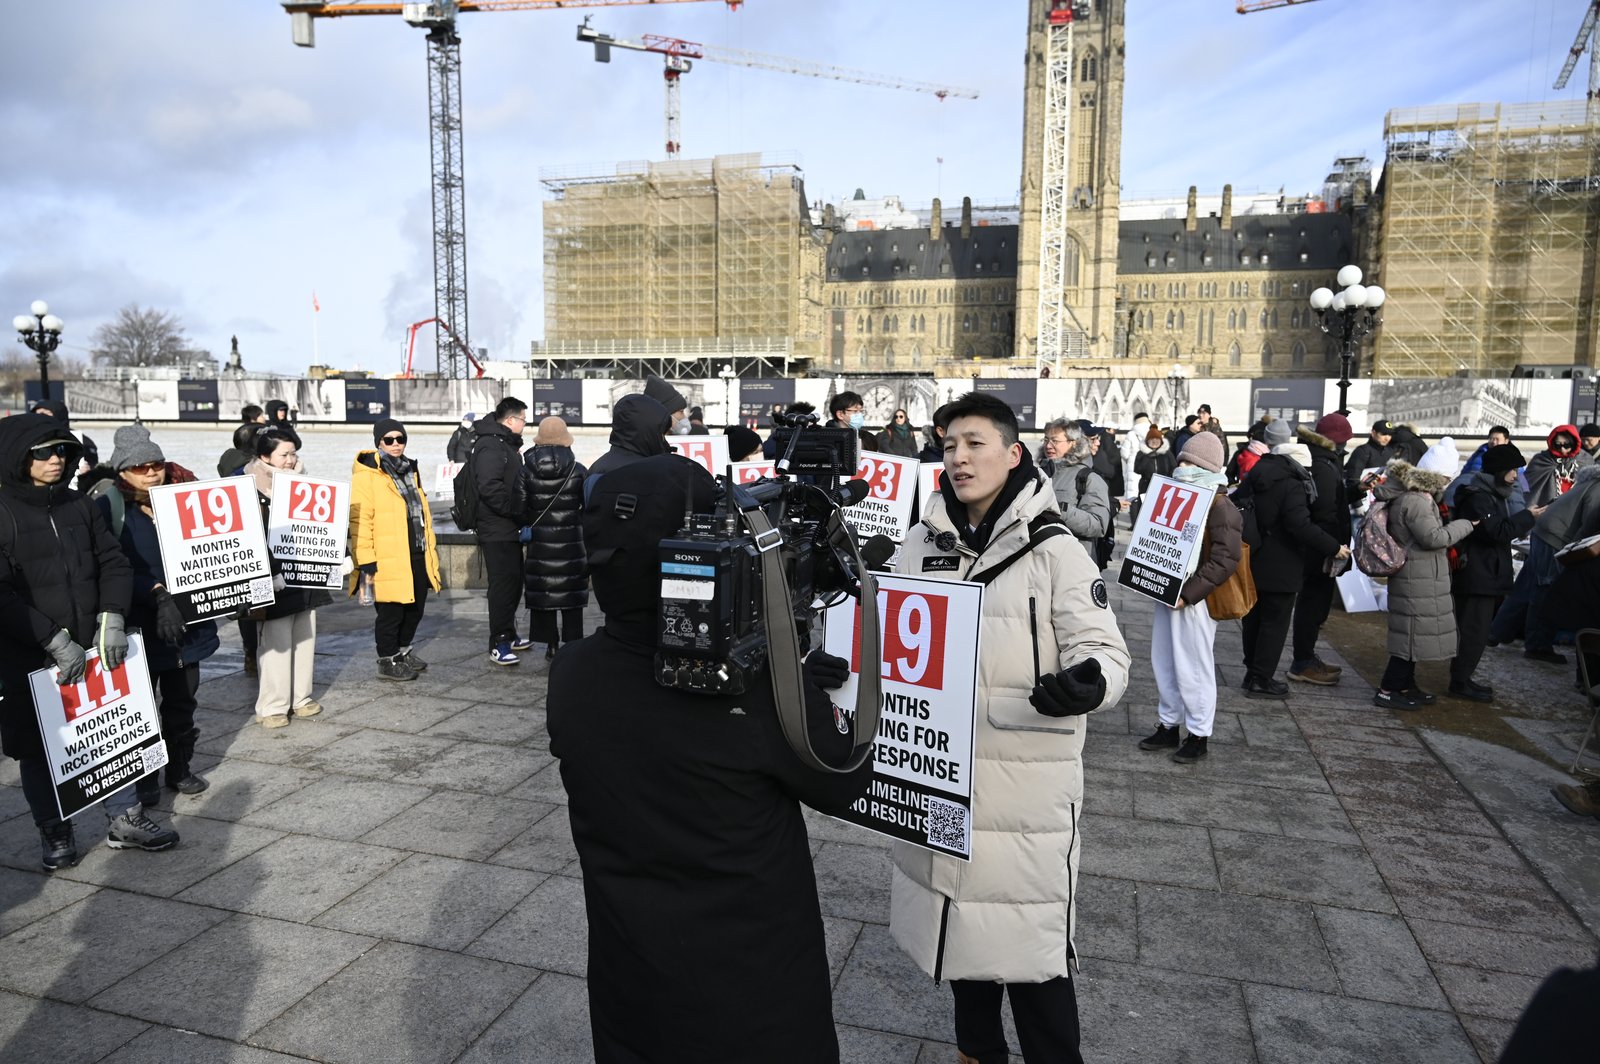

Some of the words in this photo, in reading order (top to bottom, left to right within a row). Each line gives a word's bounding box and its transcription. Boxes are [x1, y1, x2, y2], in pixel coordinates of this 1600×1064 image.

[185, 488, 233, 537] 19
[292, 482, 332, 522] 28
[1154, 486, 1193, 528] 17
[291, 524, 328, 536] MONTHS
[880, 515, 898, 526] FOR
[191, 538, 240, 556] MONTHS
[280, 534, 318, 546] WAITING
[320, 539, 336, 548] FOR
[1148, 528, 1178, 545] MONTHS
[274, 546, 294, 555] IRCC
[296, 547, 340, 558] RESPONSE
[1138, 536, 1165, 554] WAITING
[1167, 548, 1182, 560] FOR
[180, 554, 230, 572] WAITING
[233, 549, 254, 562] FOR
[282, 562, 292, 570] NO
[294, 563, 331, 574] TIMELINES
[1130, 546, 1146, 560] IRCC
[1145, 552, 1182, 574] RESPONSE
[176, 572, 202, 587] IRCC
[204, 560, 262, 582] RESPONSE
[284, 572, 296, 580] NO
[296, 573, 328, 582] RESULTS
[1132, 565, 1140, 574] NO
[1140, 568, 1170, 586] TIMELINES
[190, 590, 205, 603] NO
[1131, 576, 1140, 585] NO
[1140, 578, 1164, 595] RESULTS
[197, 601, 212, 614] NO
[212, 594, 252, 610] RESULTS
[76, 704, 128, 737] MONTHS
[64, 723, 118, 758] WAITING
[120, 711, 142, 730] FOR
[914, 726, 950, 754] FOR
[60, 753, 90, 776] IRCC
[91, 721, 152, 761] RESPONSE
[78, 774, 94, 788] NO
[85, 783, 100, 798] NO
[102, 760, 143, 790] RESULTS
[870, 801, 930, 835] RESULTS
